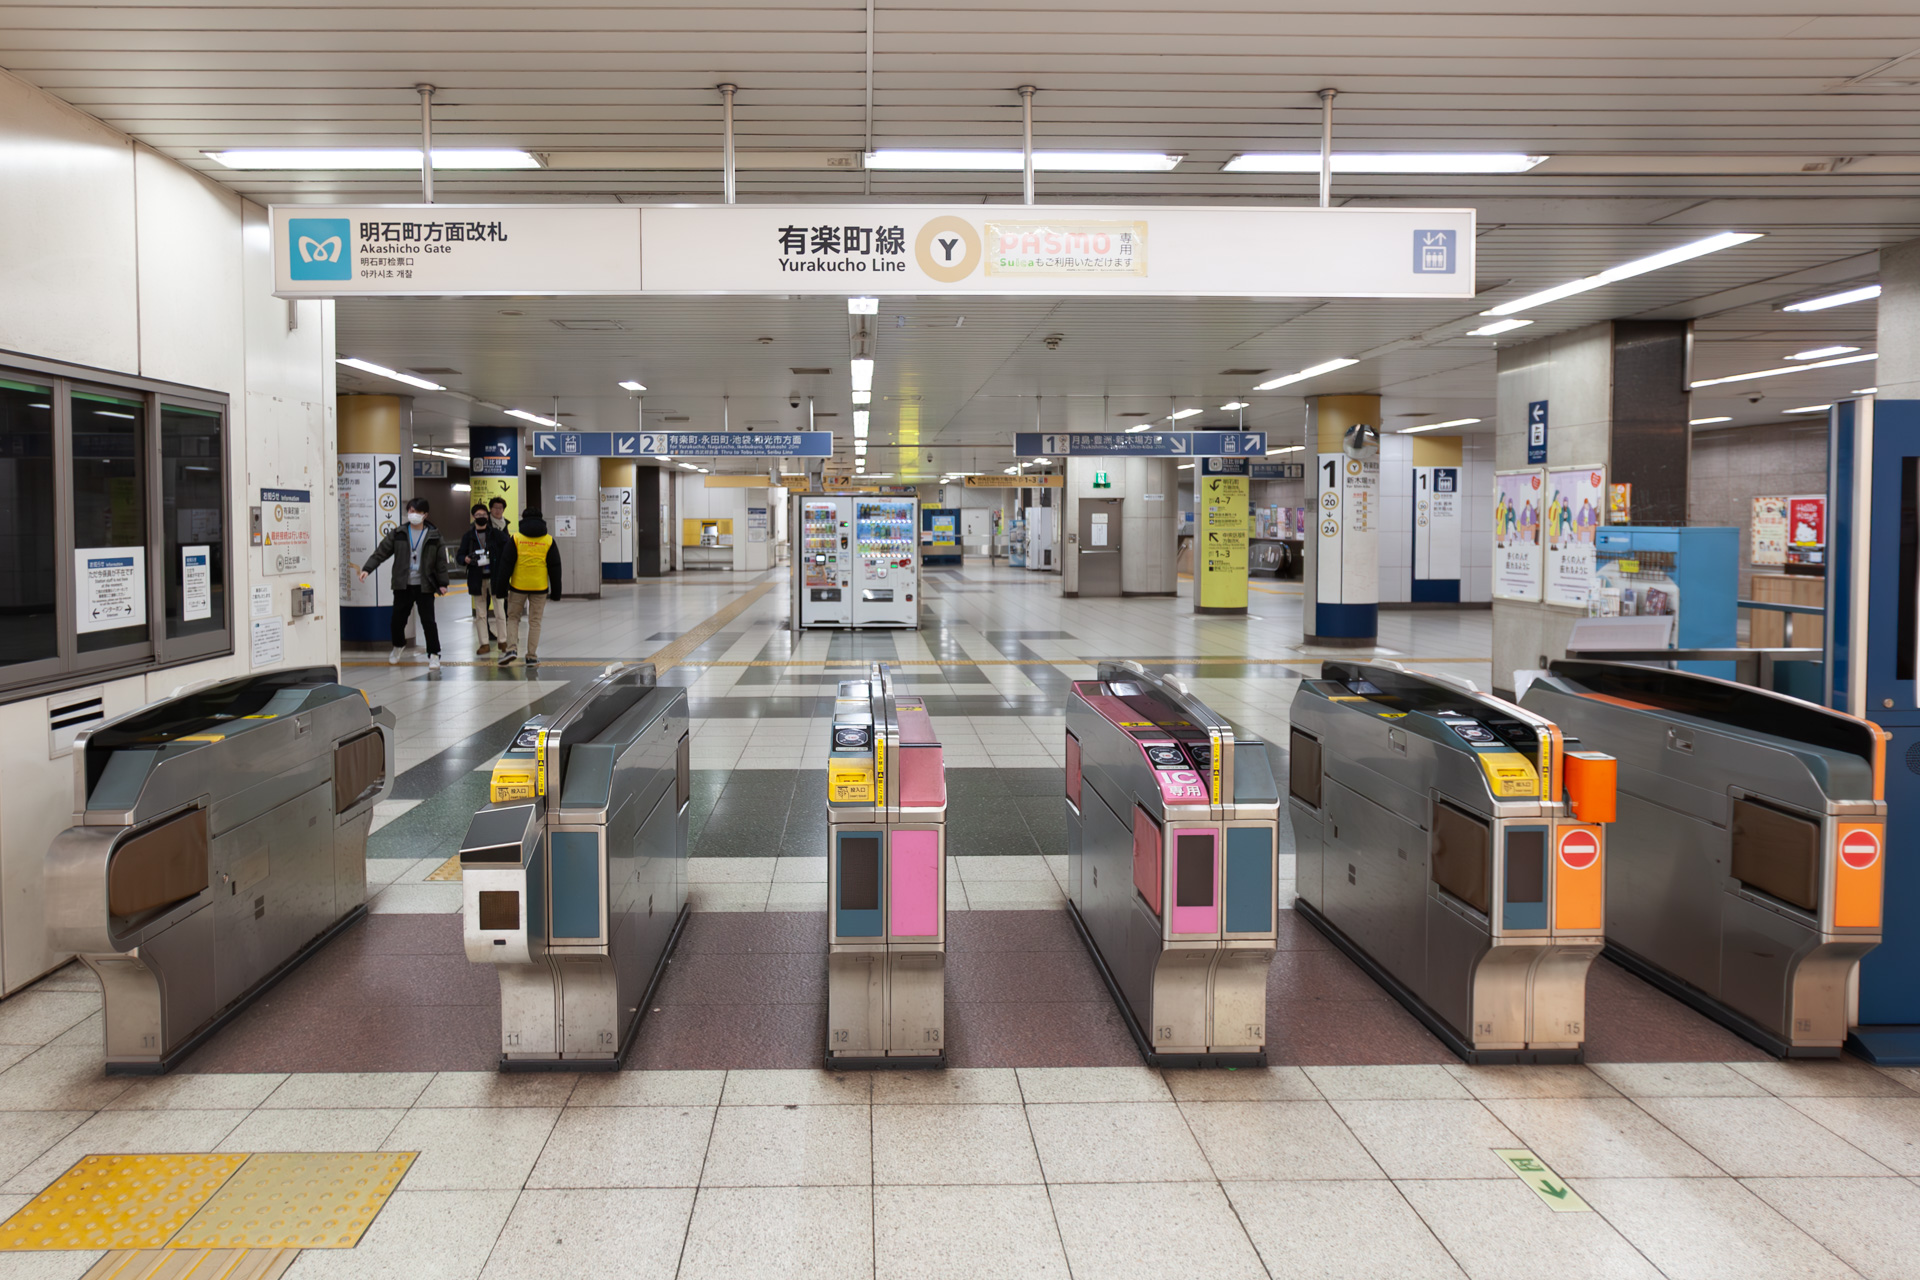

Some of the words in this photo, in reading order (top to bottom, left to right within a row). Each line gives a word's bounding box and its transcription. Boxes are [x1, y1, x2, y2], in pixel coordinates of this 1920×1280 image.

[360, 222, 507, 242] 明石町方面改札
[778, 225, 906, 255] 有楽町線
[1000, 231, 1111, 255] PASMO
[1119, 232, 1133, 256] 専用
[360, 244, 420, 254] Akashicho
[424, 244, 452, 254] Gate
[938, 238, 959, 261] Y
[778, 258, 866, 272] Yurakucho
[872, 258, 906, 272] Line
[360, 269, 394, 279] 아카시초
[396, 269, 413, 279] 개찰
[643, 435, 655, 453] 2
[1046, 436, 1055, 453] 1
[378, 460, 397, 489] 2
[424, 462, 432, 475] 2
[1322, 460, 1336, 488] 1
[1419, 474, 1427, 489] 1
[622, 491, 631, 505] 2
[1161, 772, 1198, 784] IC
[1168, 785, 1201, 797] 専用
[1158, 1027, 1172, 1039] 13
[1247, 1026, 1261, 1039] 14
[1478, 1024, 1491, 1035] 14
[1567, 1022, 1580, 1034] 15
[507, 1033, 519, 1046] 11
[599, 1032, 613, 1044] 12
[834, 1031, 848, 1042] 12
[926, 1029, 939, 1042] 13
